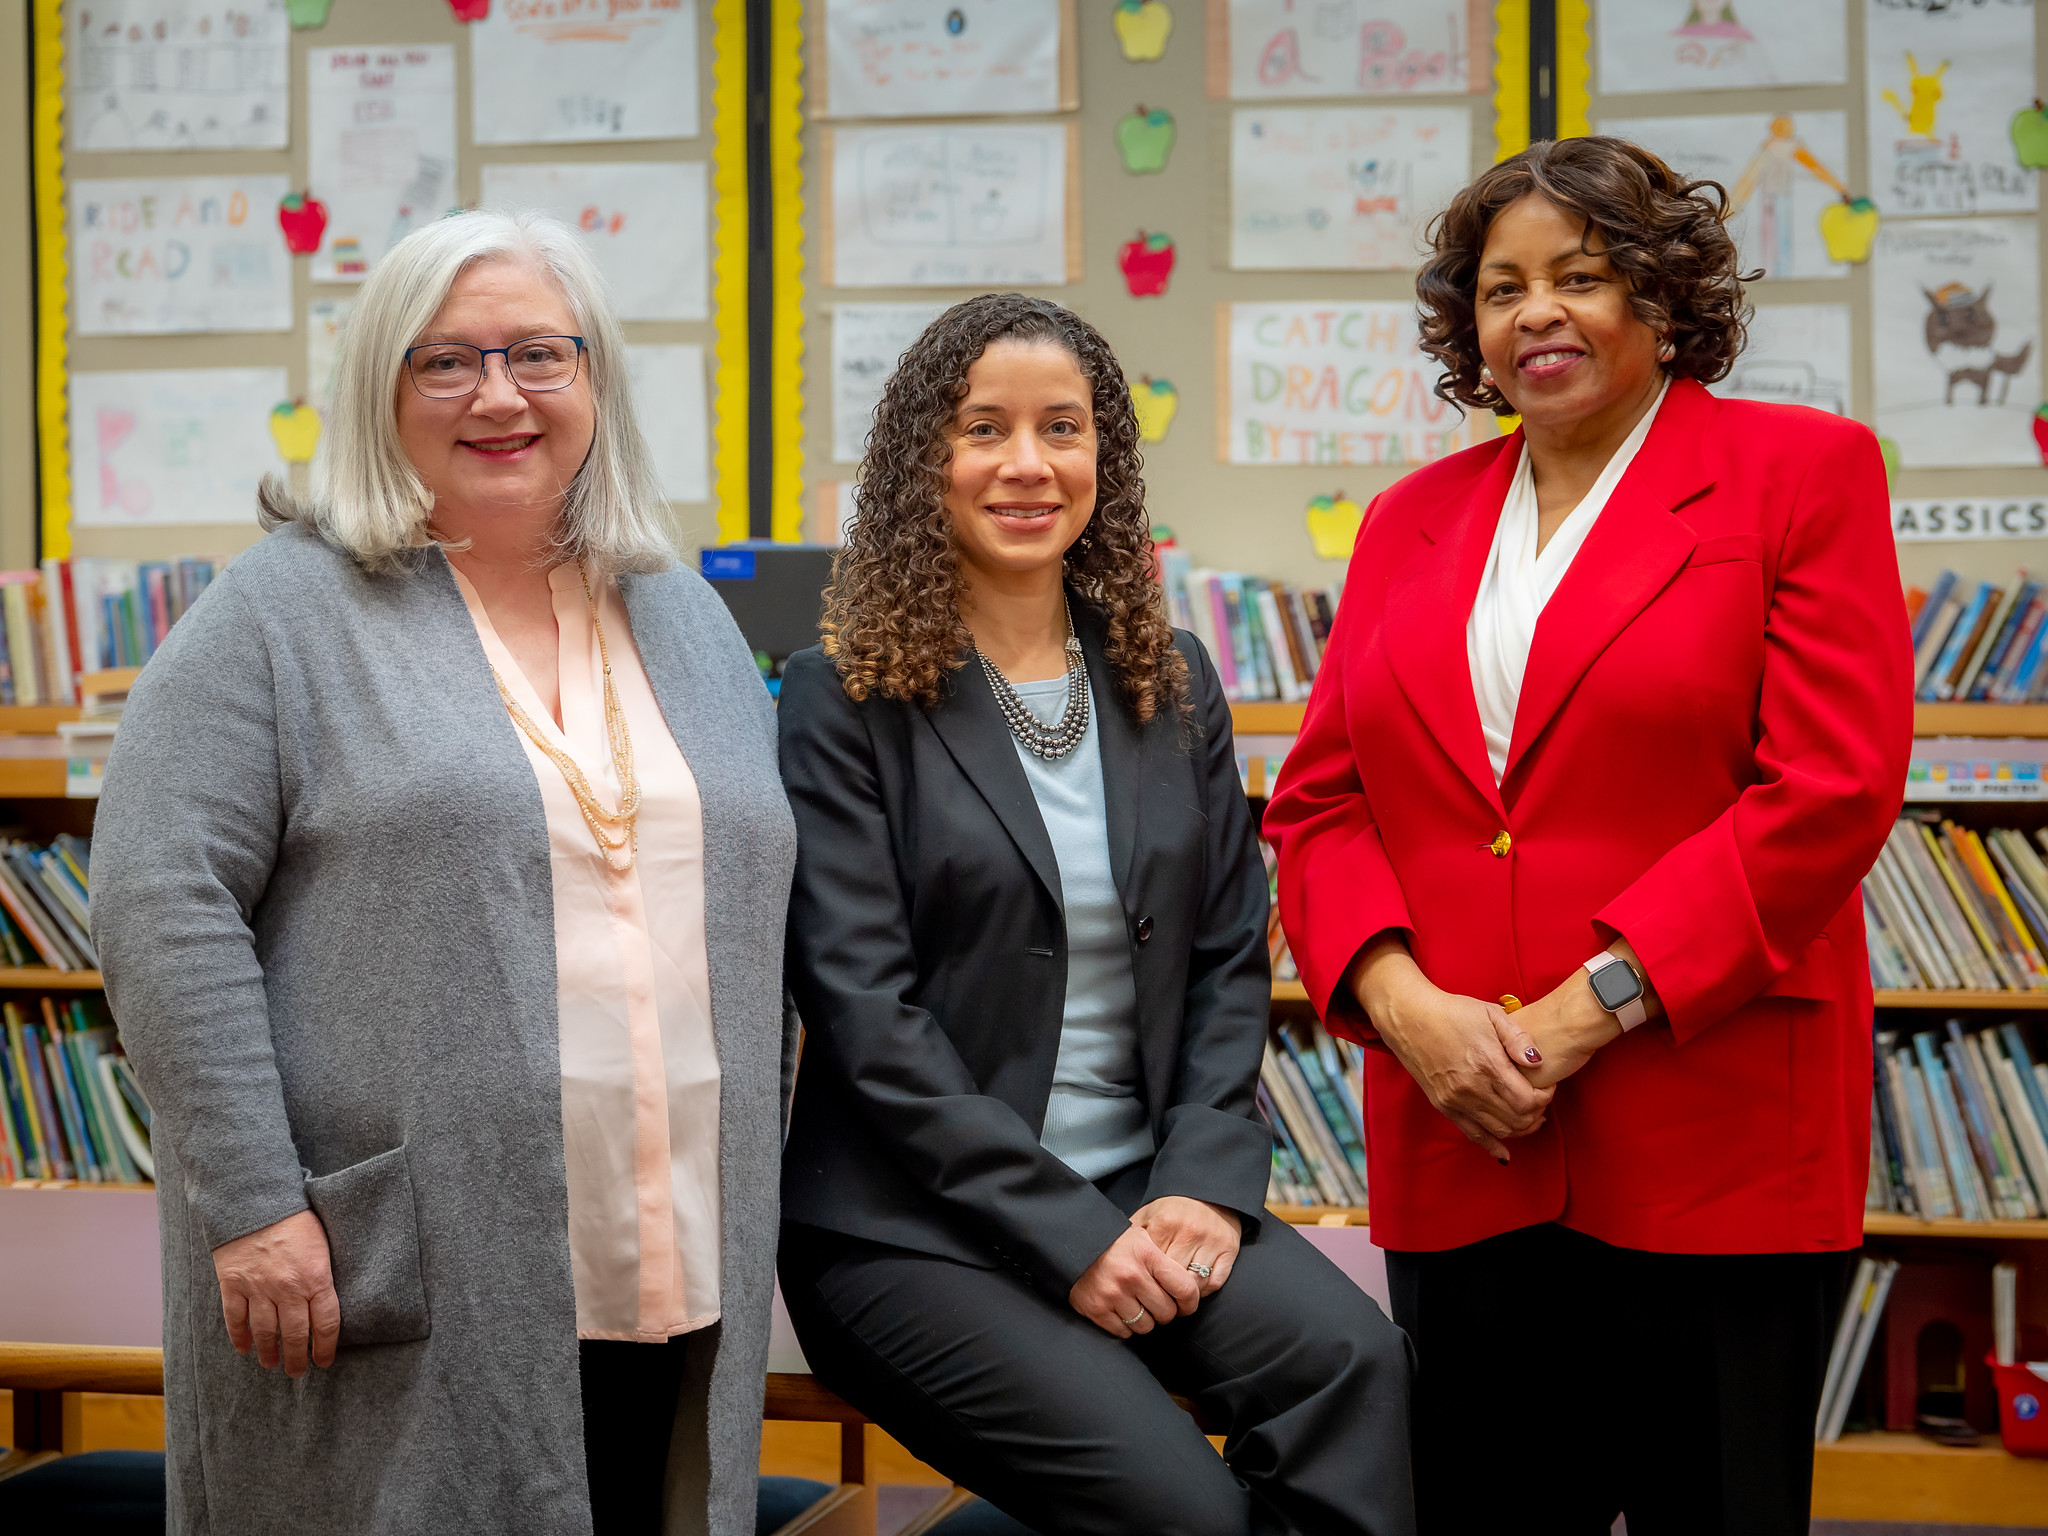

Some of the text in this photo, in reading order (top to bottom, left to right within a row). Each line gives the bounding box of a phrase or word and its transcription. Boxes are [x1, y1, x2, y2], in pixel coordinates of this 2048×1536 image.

[1254, 311, 1401, 354] CATCH
[1250, 362, 1448, 424] DRAGON
[1246, 418, 1285, 460] BY
[1291, 430, 1355, 468] THE
[1898, 503, 2045, 533] ASSICS
